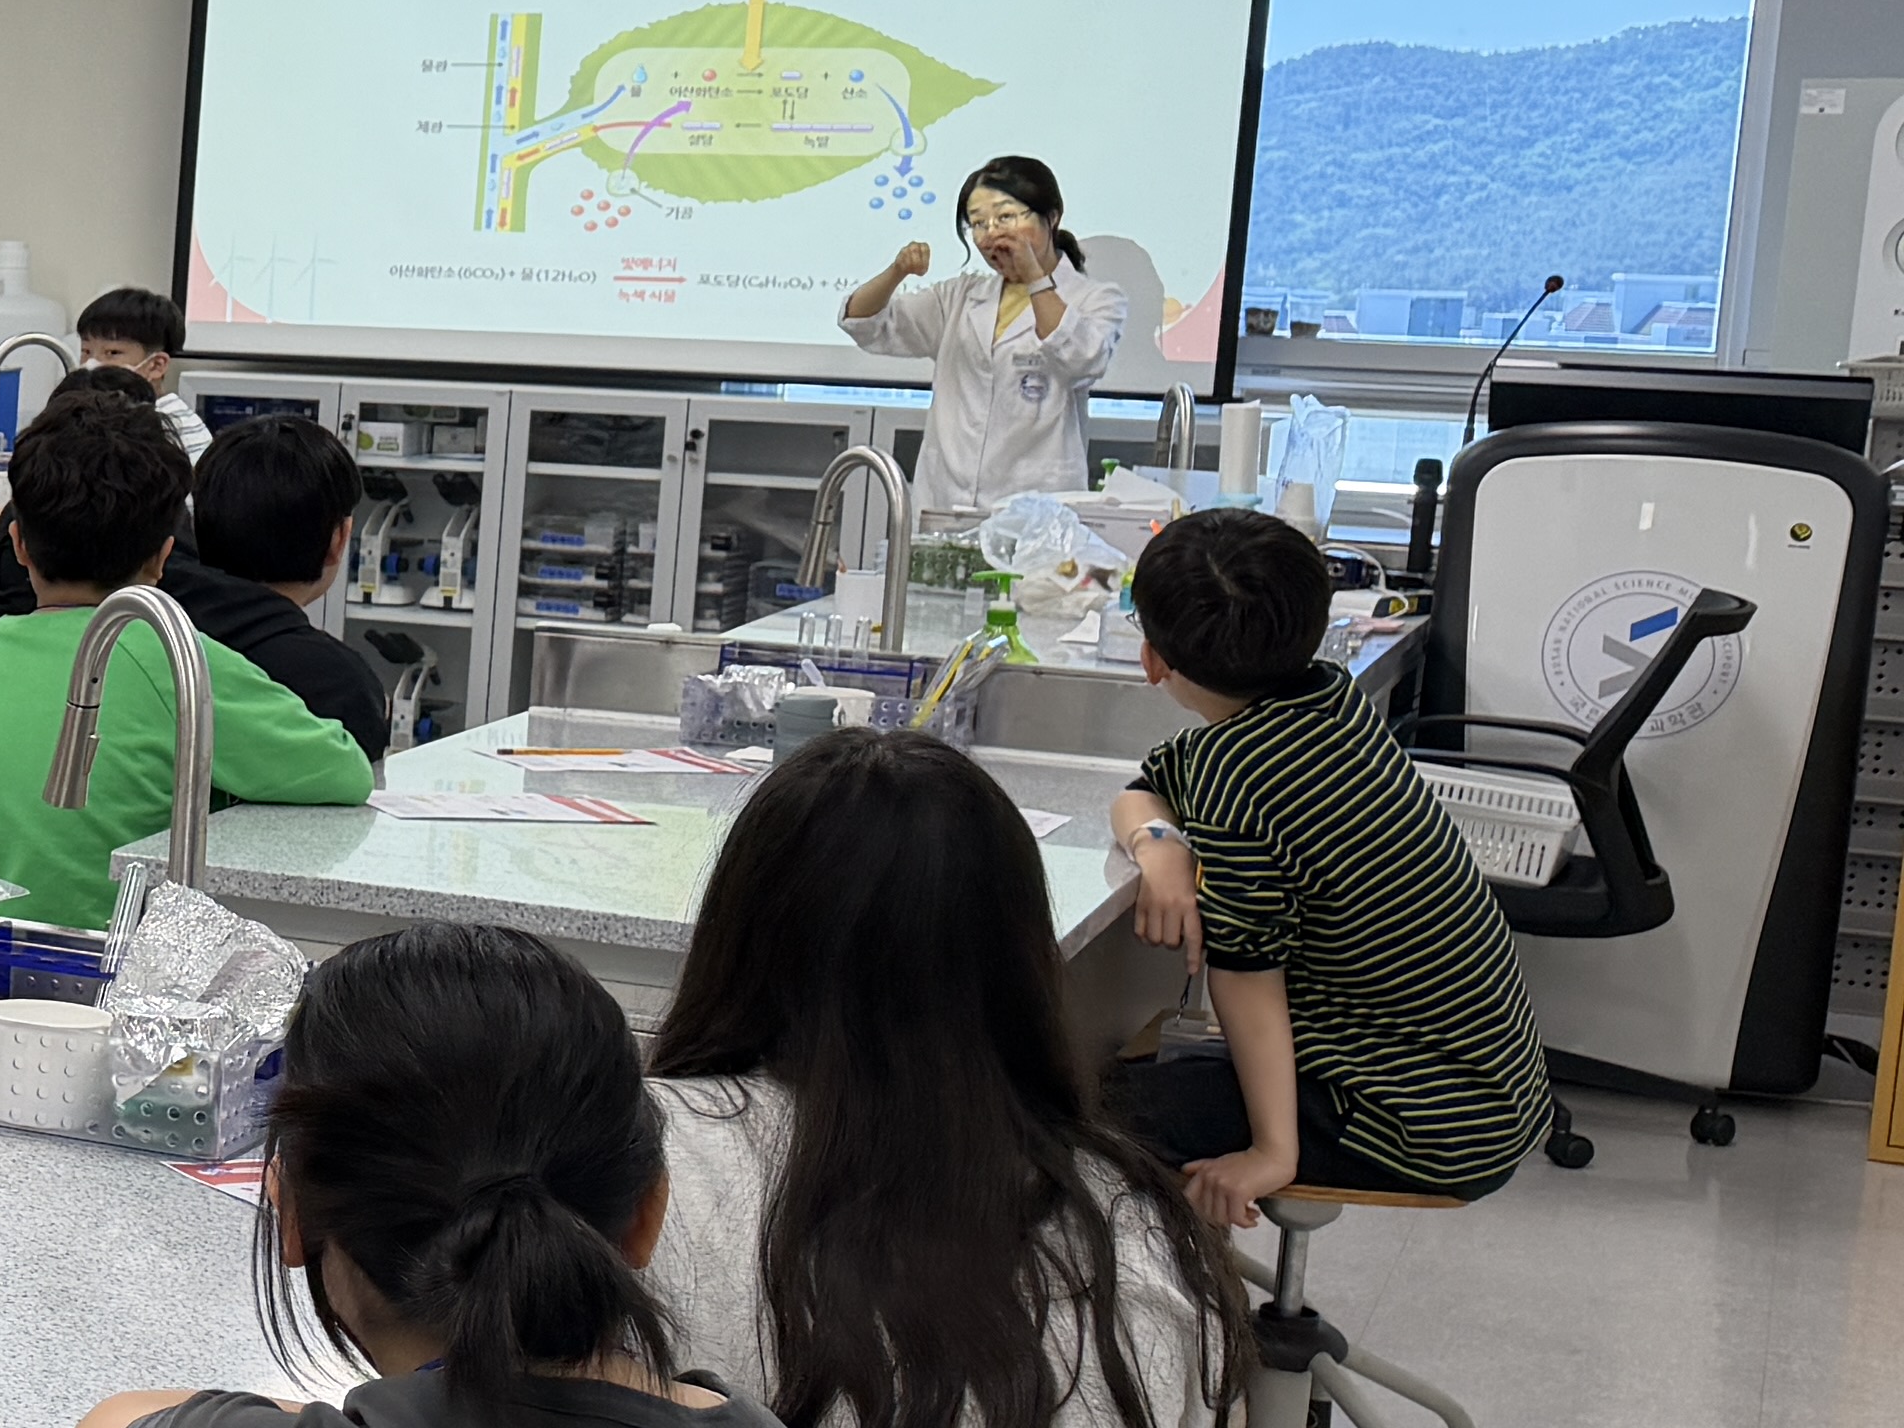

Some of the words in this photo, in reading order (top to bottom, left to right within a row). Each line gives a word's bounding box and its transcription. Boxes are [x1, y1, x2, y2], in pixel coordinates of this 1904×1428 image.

[420, 58, 448, 73] 물관
[669, 85, 733, 99] 이산화탄소
[771, 86, 809, 100] 포도당
[841, 86, 868, 100] 산소
[665, 206, 694, 221] 기공
[1613, 578, 1673, 592] SCIENCE
